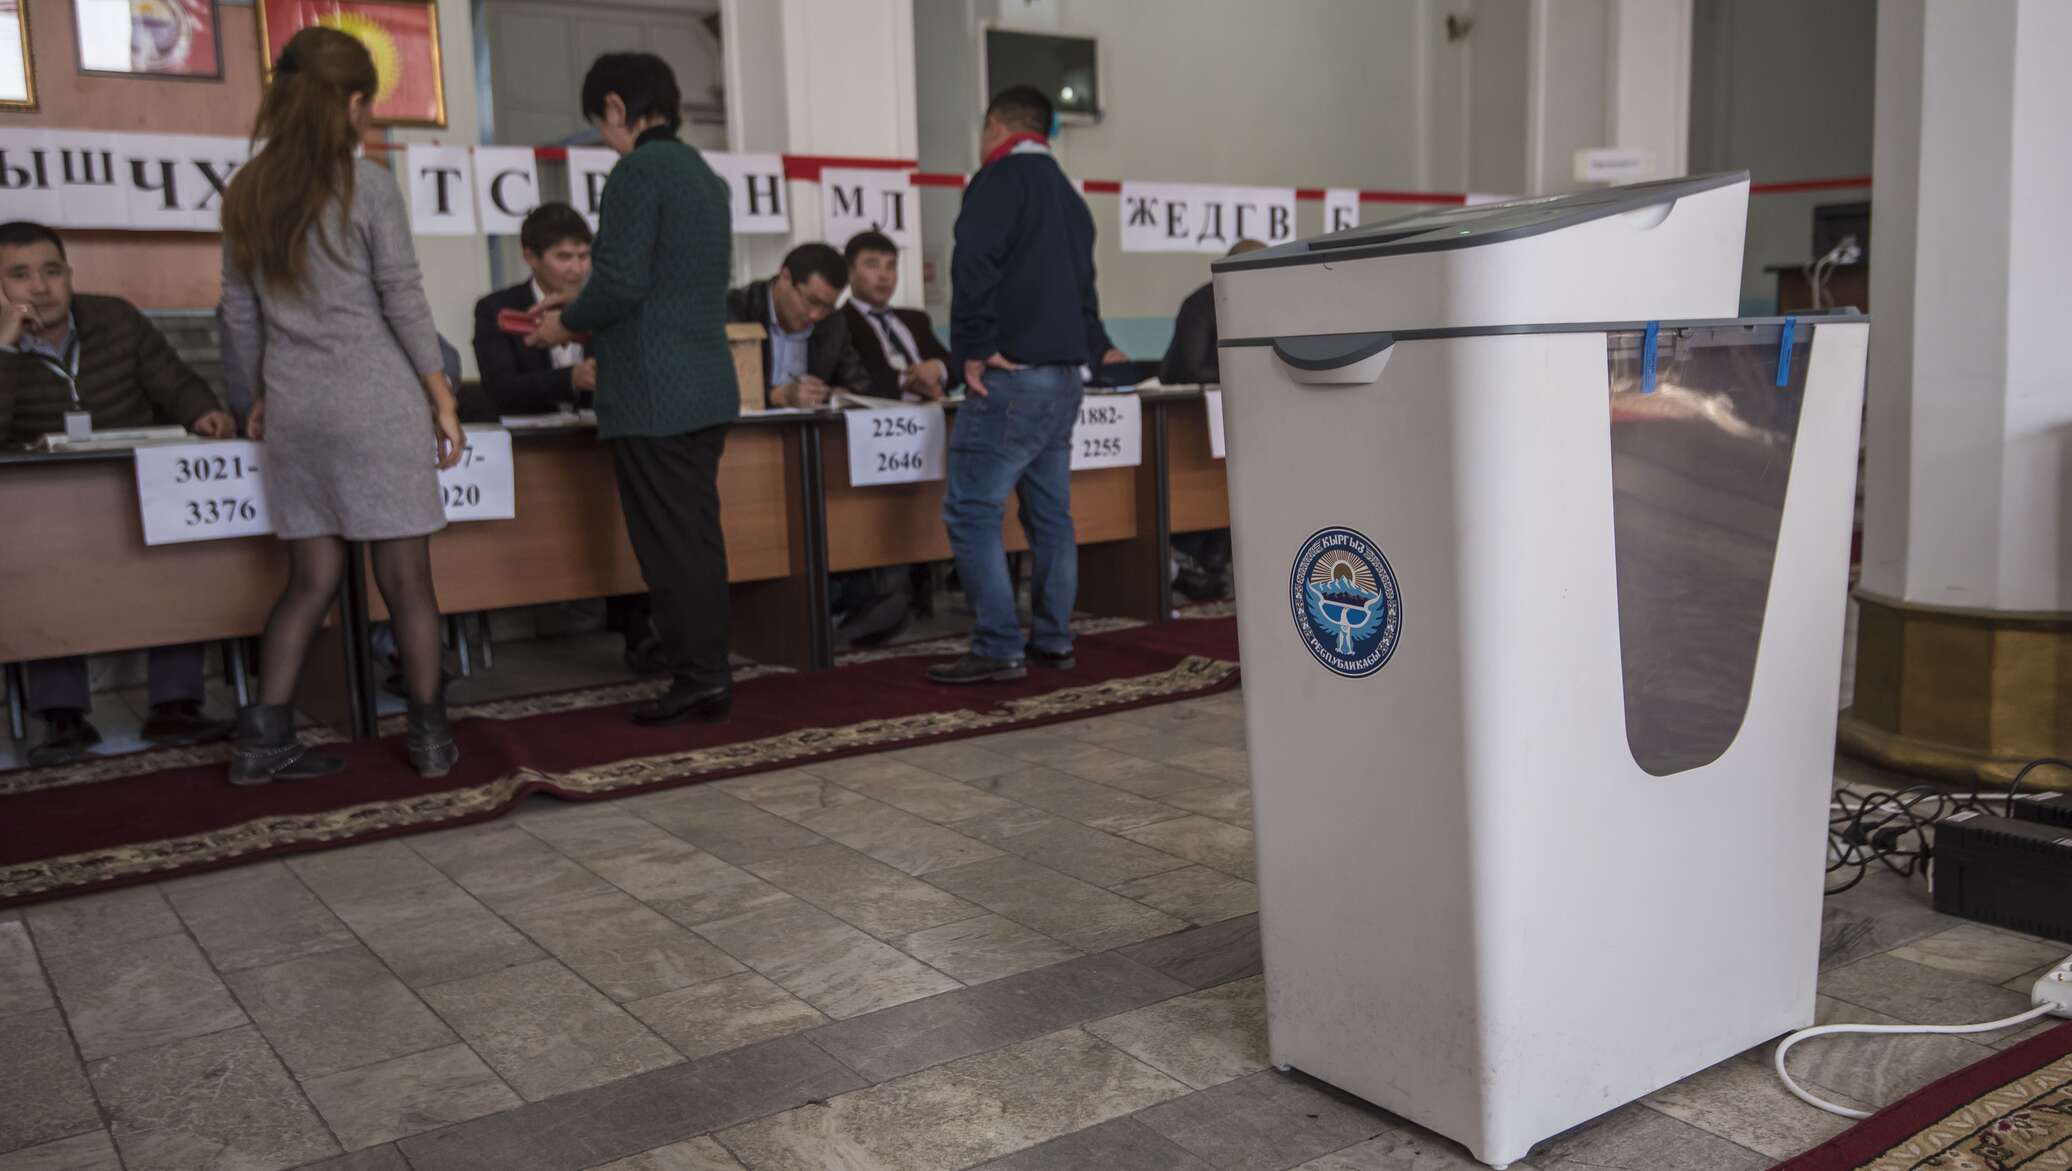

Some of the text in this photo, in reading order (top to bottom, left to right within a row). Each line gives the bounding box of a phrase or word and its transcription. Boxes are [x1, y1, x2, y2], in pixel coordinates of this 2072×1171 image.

[421, 167, 461, 216] Т
[490, 169, 531, 217] С
[744, 174, 781, 216] Н
[872, 416, 926, 438] 2256-
[1081, 405, 1124, 426] 1882-
[1083, 437, 1121, 458] 2255
[176, 456, 259, 483] 3021-
[877, 451, 923, 472] 2646
[185, 498, 256, 526] 3376
[1322, 534, 1365, 553] КЫРГЫЗ
[1310, 638, 1381, 670] РЕСПУБЛИКАСЫ
